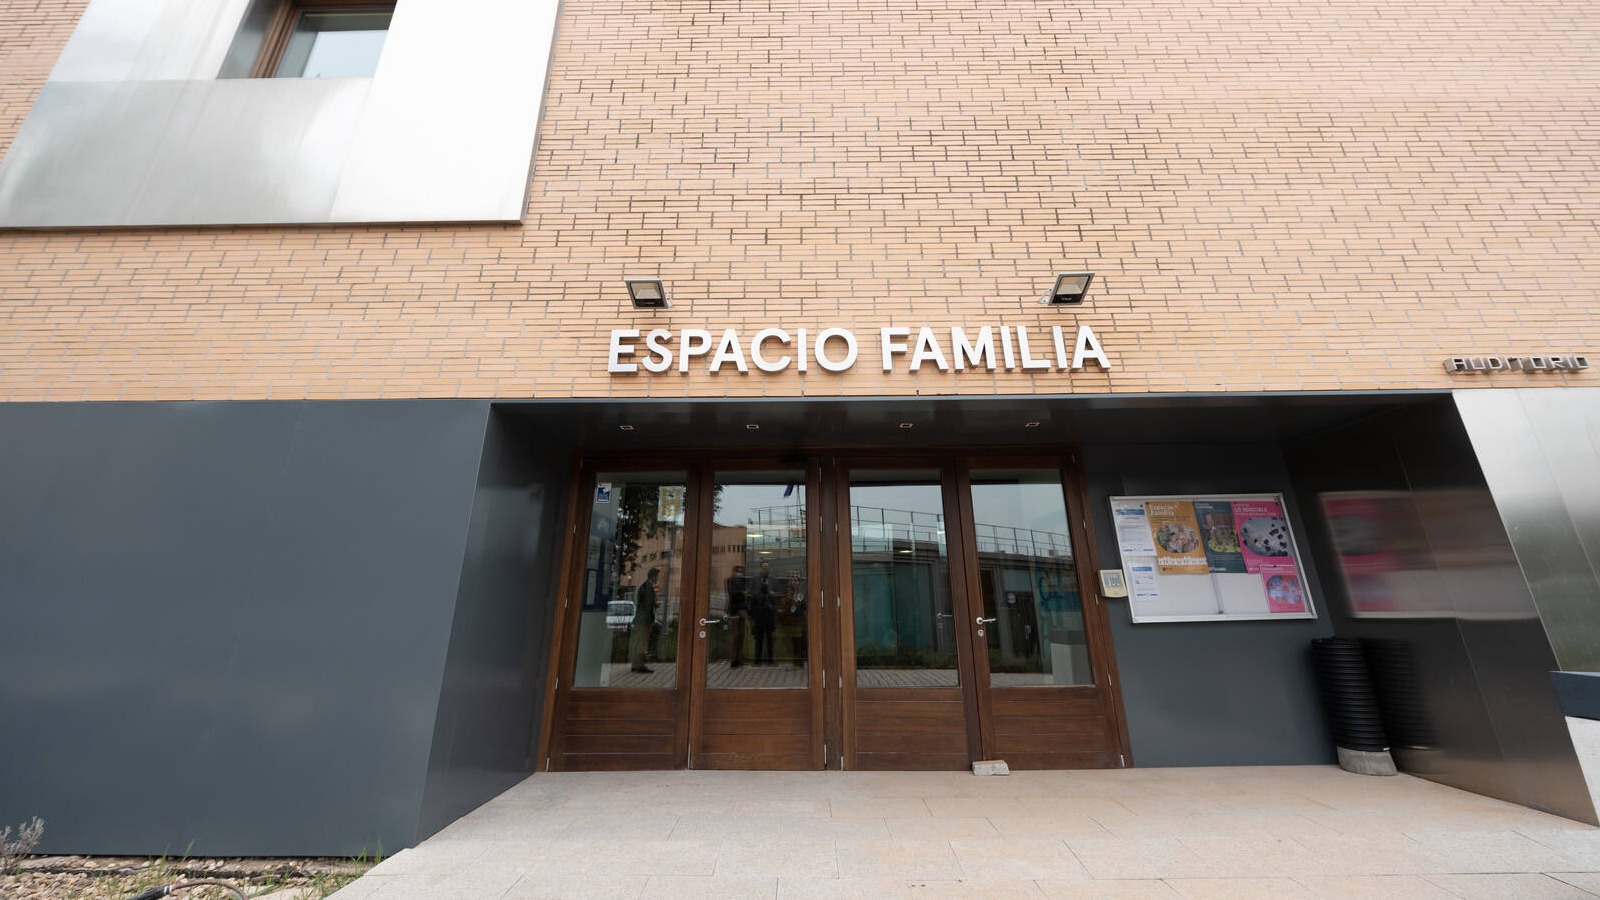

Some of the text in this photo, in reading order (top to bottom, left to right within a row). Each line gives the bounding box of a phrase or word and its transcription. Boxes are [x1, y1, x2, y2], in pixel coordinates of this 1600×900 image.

[608, 325, 1111, 374] ESPACIO FAMILIA
[1447, 356, 1589, 372] AUDITORIO
